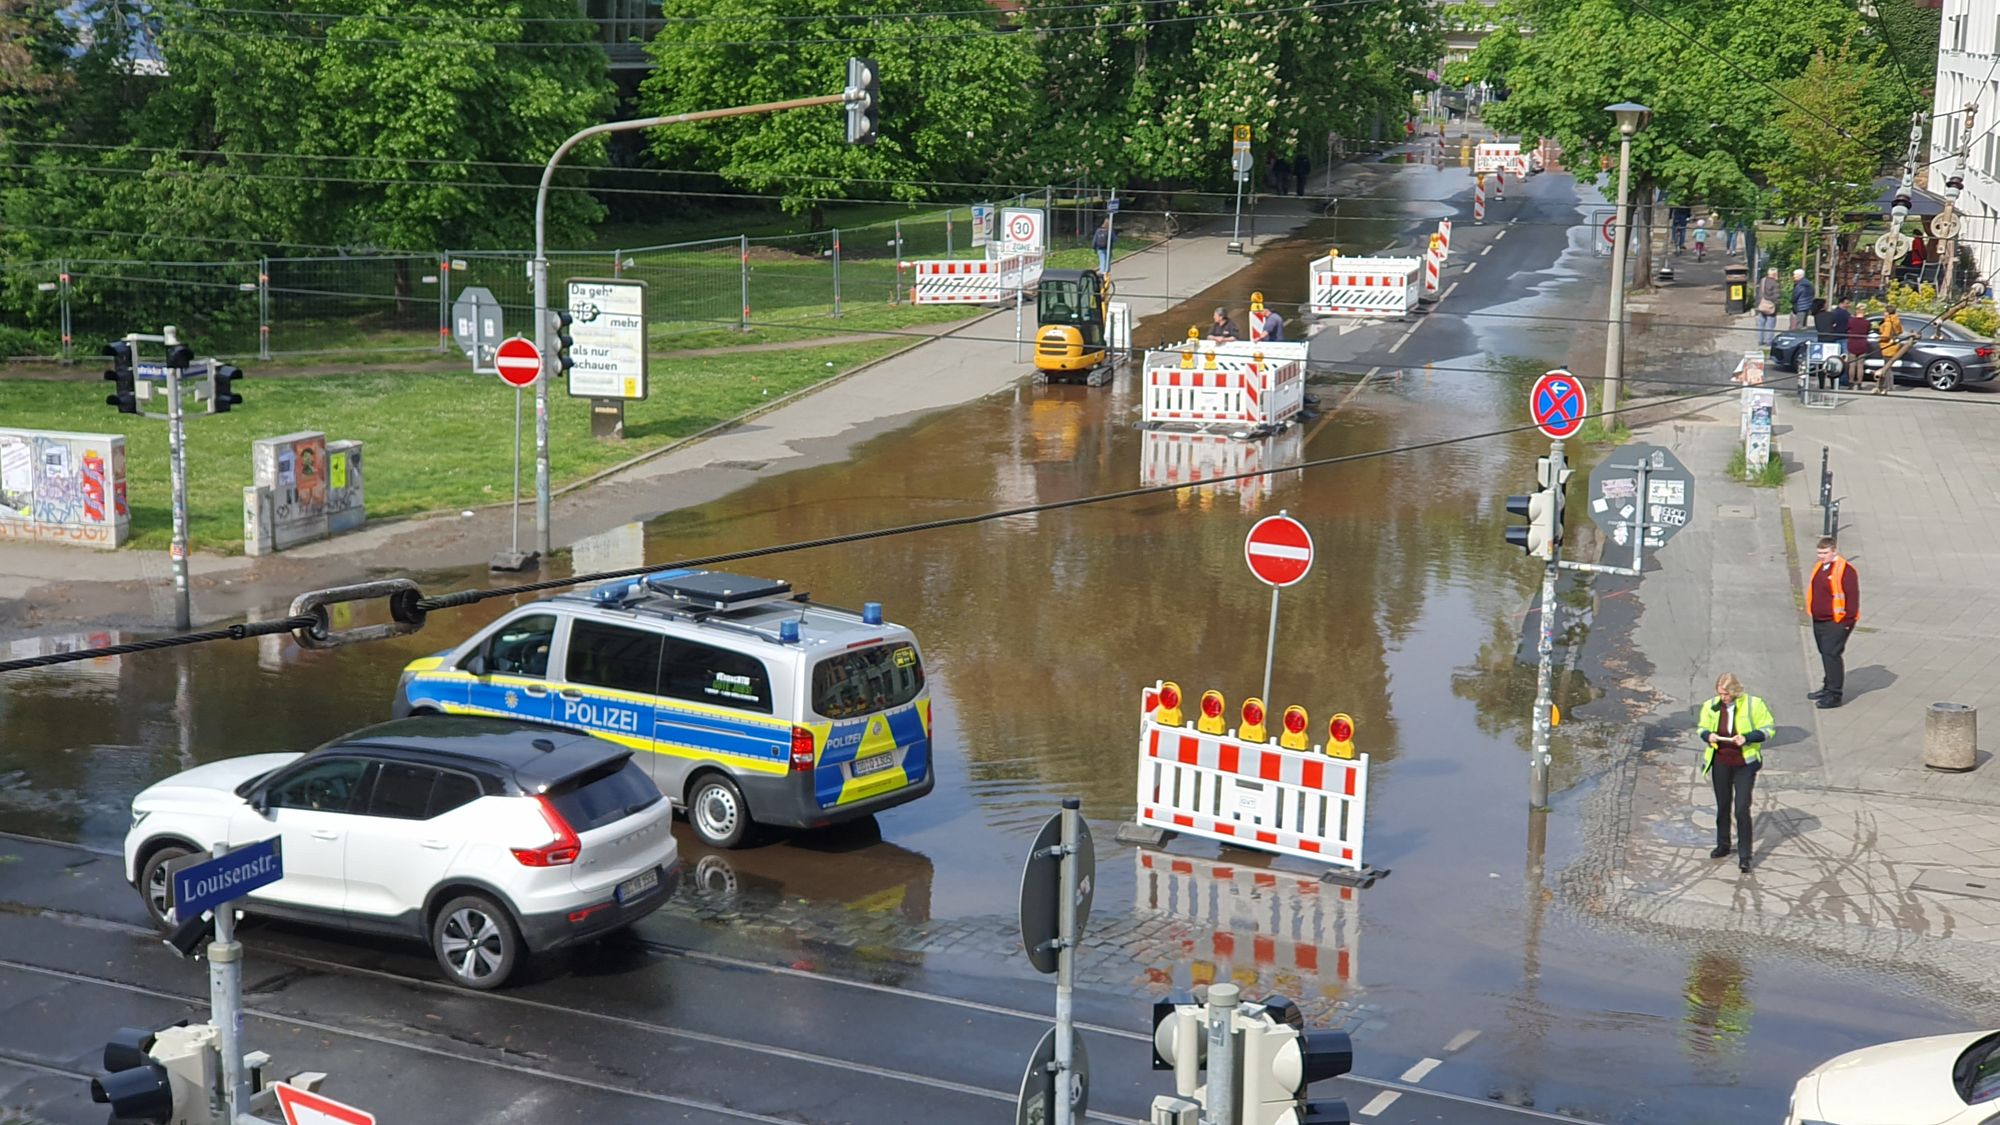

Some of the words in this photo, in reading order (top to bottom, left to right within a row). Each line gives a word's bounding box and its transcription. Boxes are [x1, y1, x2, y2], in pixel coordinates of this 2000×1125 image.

[1015, 222, 1030, 235] 30
[571, 284, 586, 295] Da
[610, 318, 639, 328] mehr
[572, 345, 588, 356] als
[591, 347, 609, 357] nur
[573, 360, 618, 371] schauen
[565, 701, 638, 732] POLIZEI
[826, 733, 861, 750] POLIZEI
[183, 855, 277, 903] Louisenstr.
